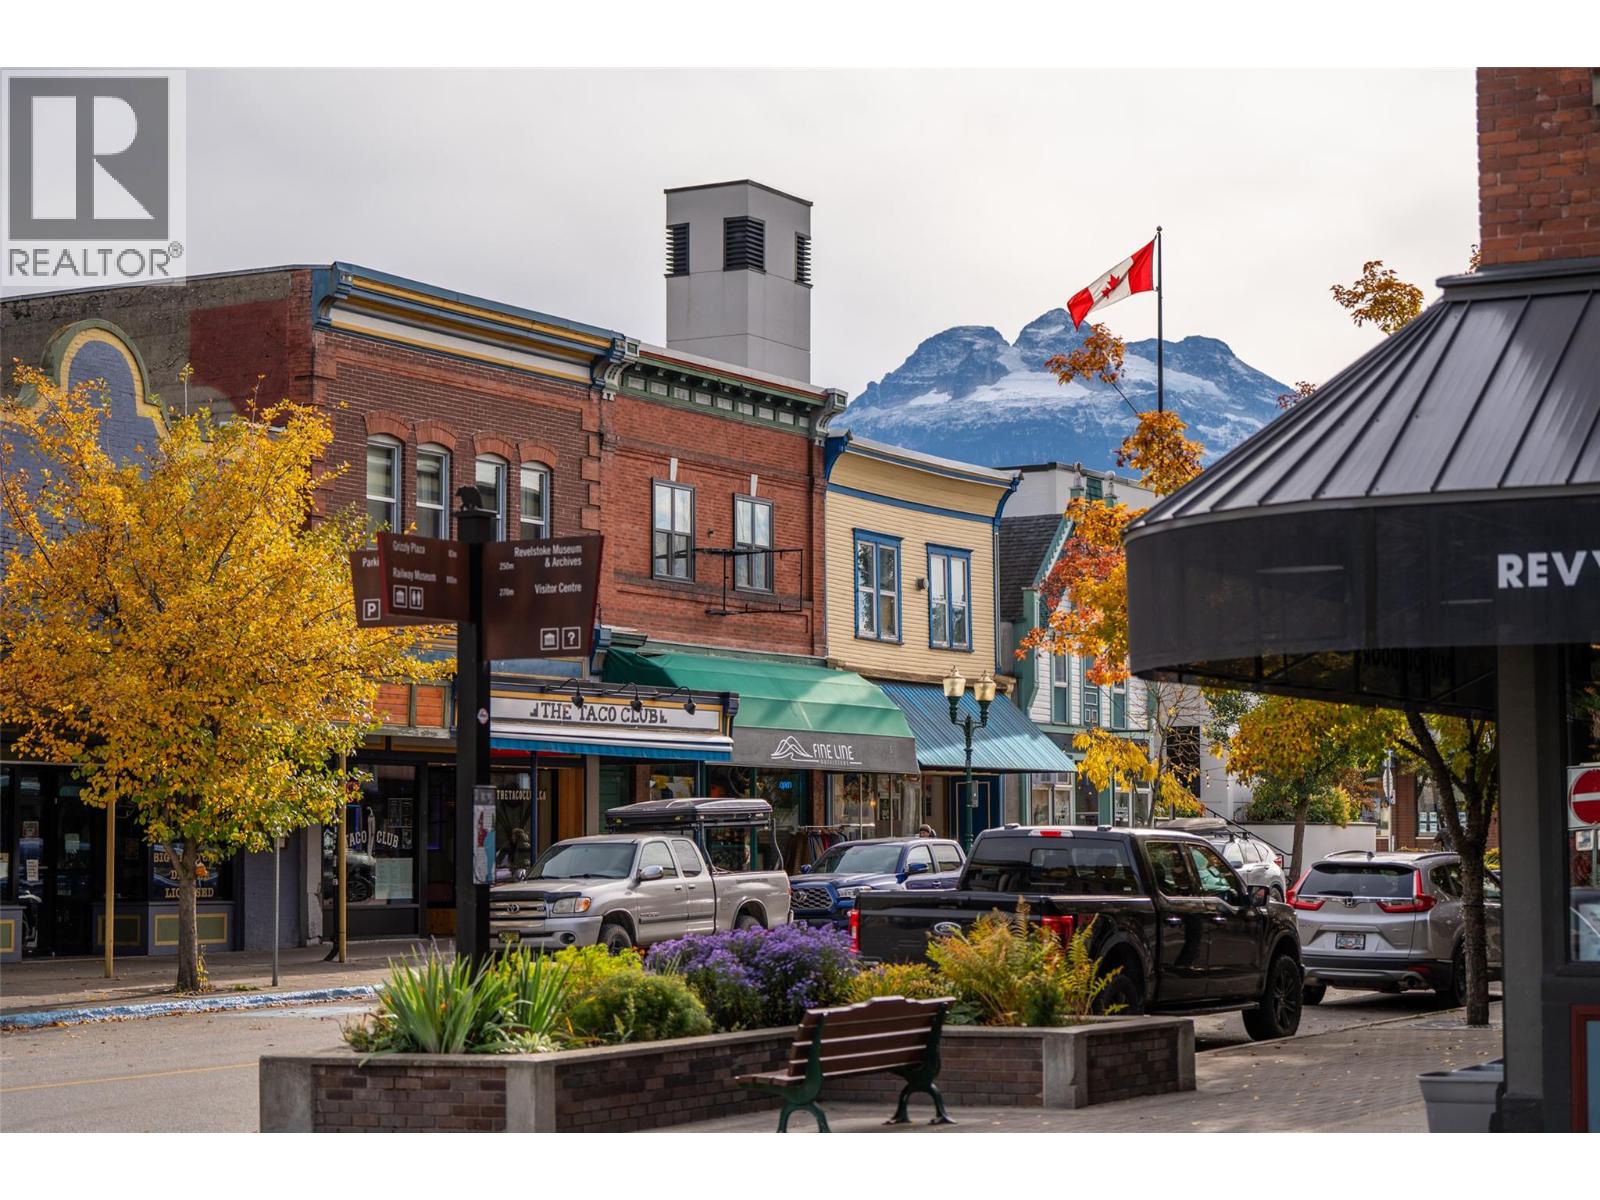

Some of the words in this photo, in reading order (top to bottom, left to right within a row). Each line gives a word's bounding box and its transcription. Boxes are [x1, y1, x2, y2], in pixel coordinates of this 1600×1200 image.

[513, 546, 551, 557] Revelstoke
[552, 544, 582, 555] Museum
[544, 557, 550, 568] &
[551, 556, 582, 567] Archives
[1497, 550, 1600, 589] REV
[534, 583, 557, 594] Visitor
[558, 582, 582, 593] Centre
[540, 702, 572, 720] THE
[580, 705, 617, 722] TACO
[620, 707, 658, 724] CLUB
[812, 743, 833, 759] FINE
[833, 745, 854, 760] LINE
[376, 830, 399, 848] CLUB
[165, 887, 214, 898] LICSED
